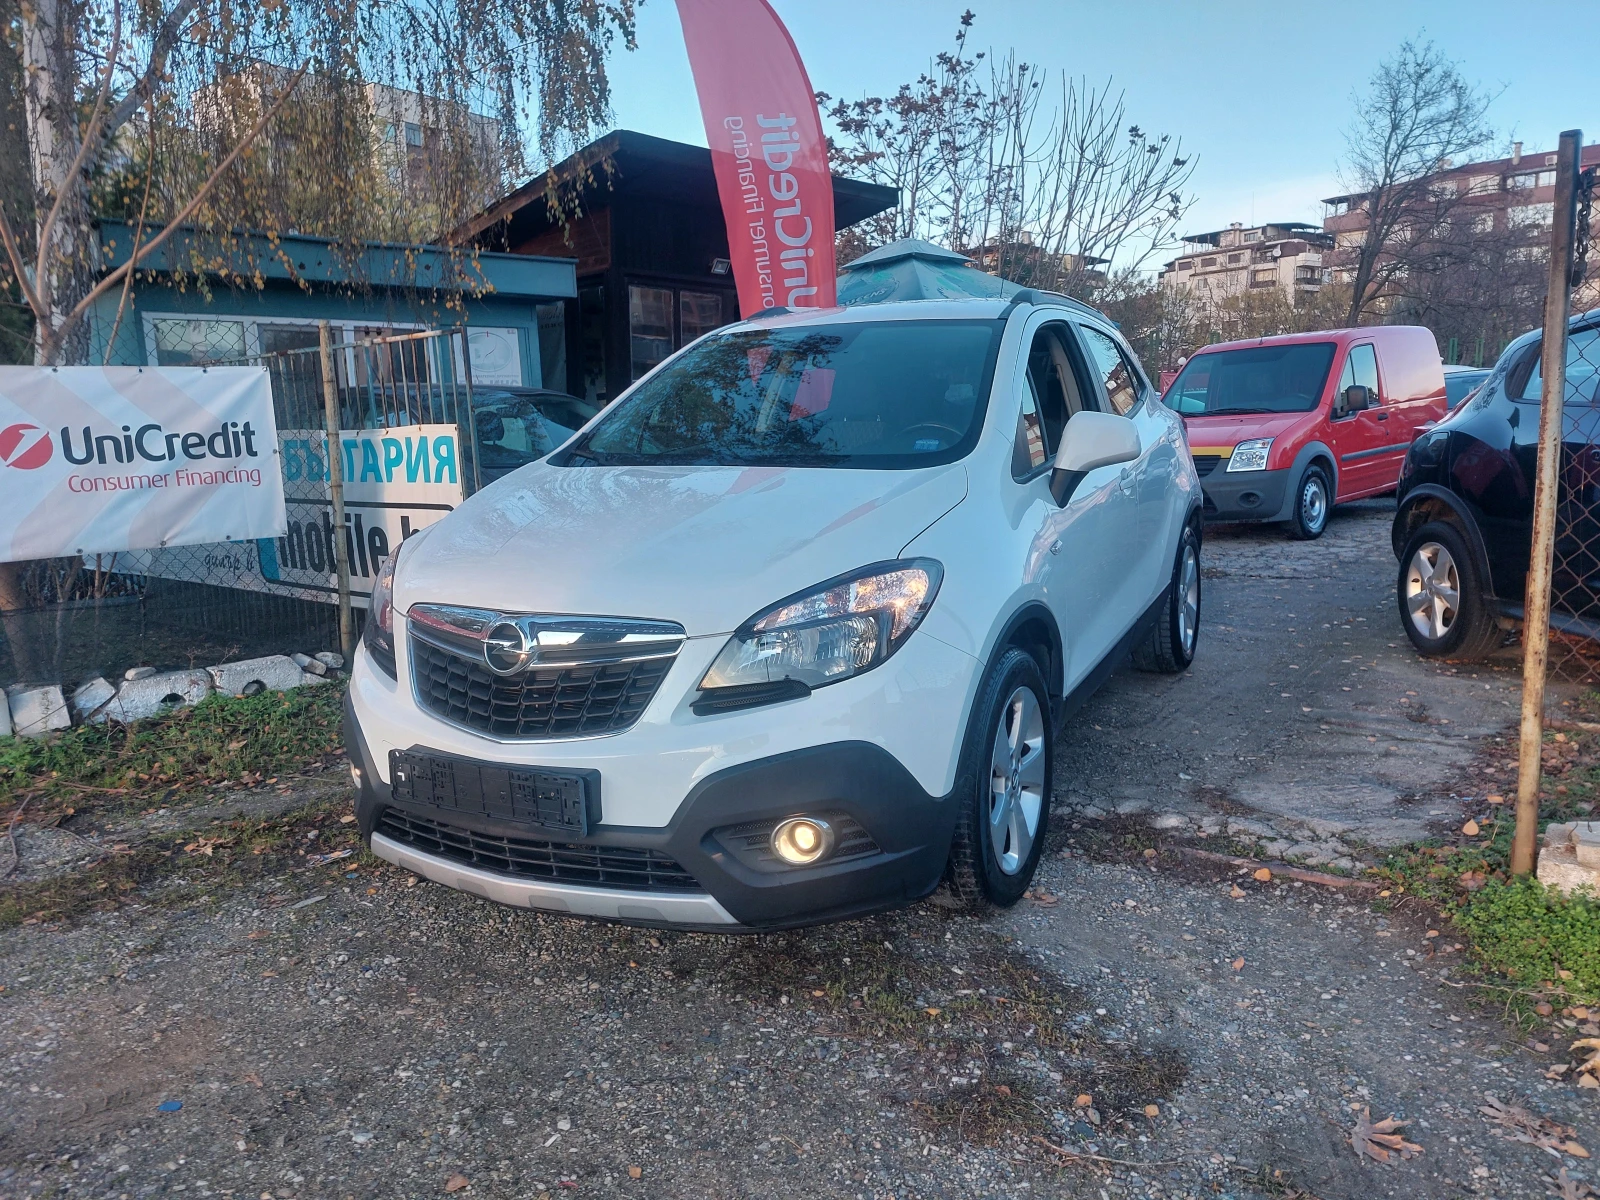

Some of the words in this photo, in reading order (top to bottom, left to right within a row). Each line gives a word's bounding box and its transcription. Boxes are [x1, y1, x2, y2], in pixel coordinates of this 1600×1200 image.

[60, 421, 258, 466] UniCredit
[68, 472, 170, 493] Consumer
[175, 465, 262, 487] Financing
